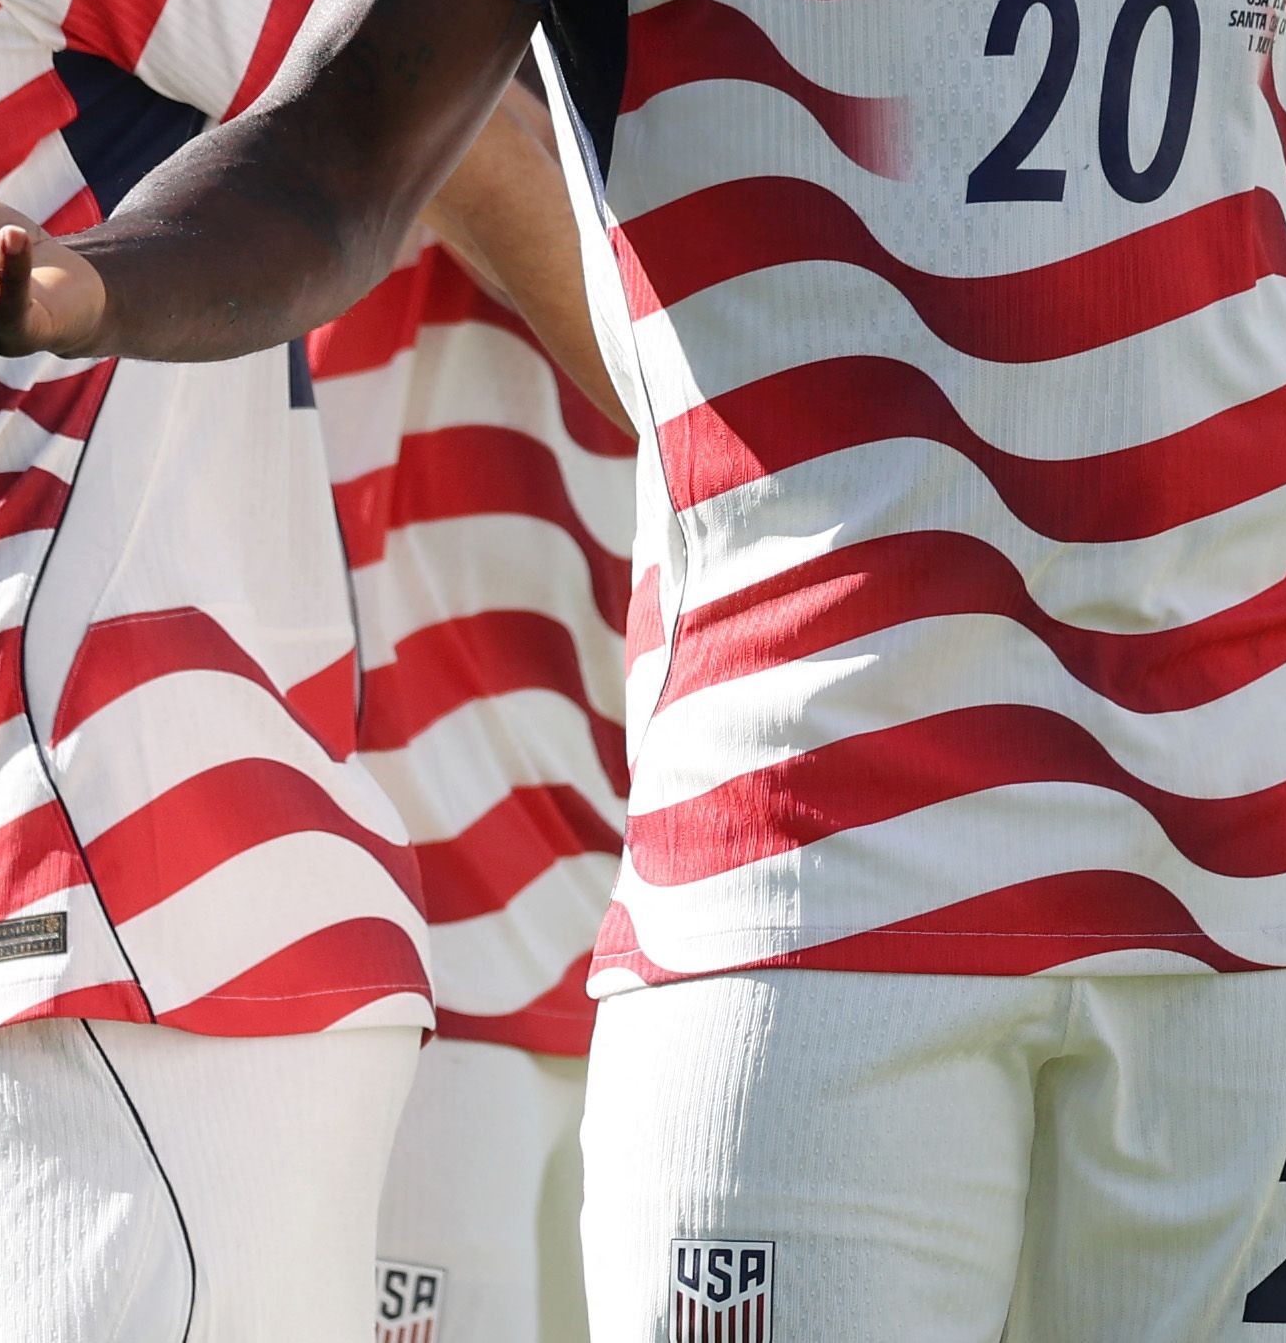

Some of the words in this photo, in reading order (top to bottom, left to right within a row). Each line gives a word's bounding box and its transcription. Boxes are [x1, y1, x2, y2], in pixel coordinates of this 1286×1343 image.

[1229, 10, 1267, 30] SANTA
[1248, 35, 1254, 51] 1
[678, 1248, 766, 1303] USA
[376, 1269, 437, 1320] SA
